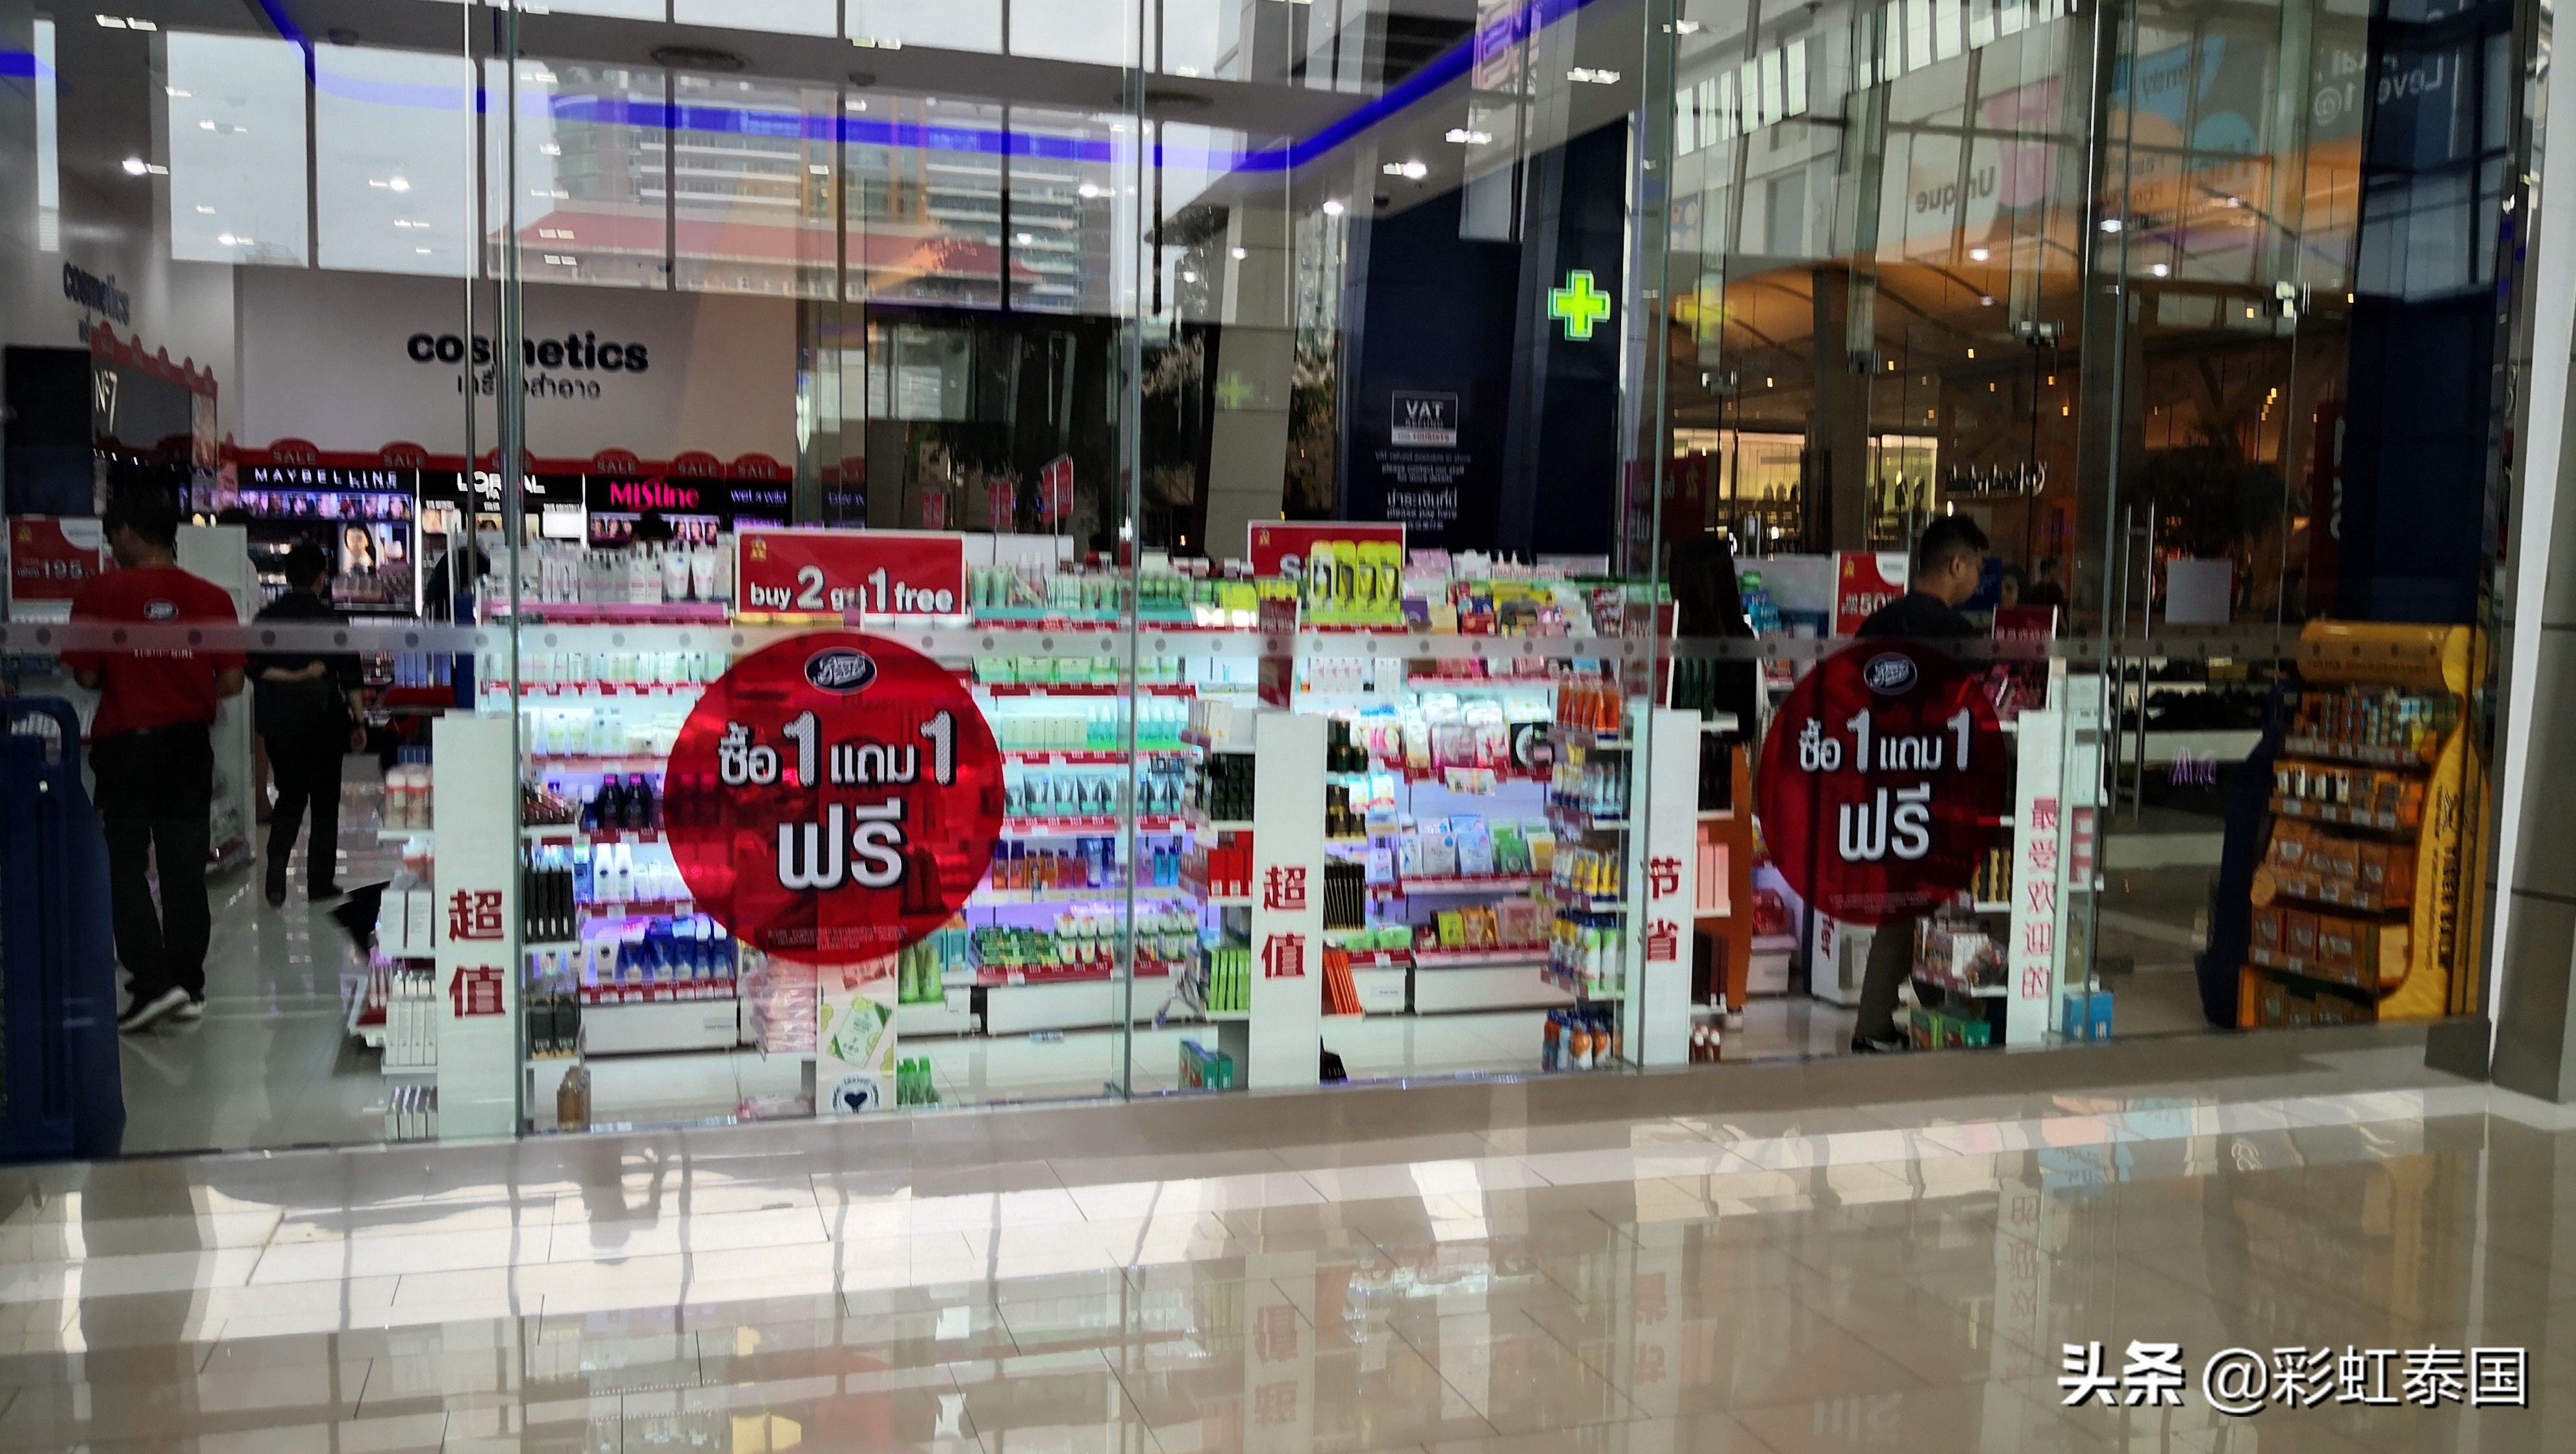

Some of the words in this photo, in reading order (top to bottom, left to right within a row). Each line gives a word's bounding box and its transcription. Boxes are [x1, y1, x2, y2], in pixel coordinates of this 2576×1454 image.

[407, 330, 649, 373] cosetics
[1406, 399, 1444, 419] VAT
[254, 467, 398, 490] MAYBELLINE
[750, 580, 791, 611] buy
[797, 565, 825, 610] 2
[868, 566, 887, 613] 1
[895, 581, 954, 613] free
[718, 722, 777, 785] ซื้อ
[783, 711, 816, 787] 1
[831, 744, 915, 784] แถม
[921, 711, 952, 786] 1
[1799, 717, 1841, 773] ซื้อ
[1847, 708, 1871, 774] 1
[1880, 735, 1942, 771] แถม
[1948, 706, 1970, 772] 1
[778, 797, 902, 891] ฟรี
[1838, 782, 1931, 863] ฟรี
[1261, 865, 1307, 980] 超值
[1644, 855, 1683, 965] 节省
[2022, 796, 2058, 1000] 最受欢迎的
[448, 889, 506, 1019] 超值
